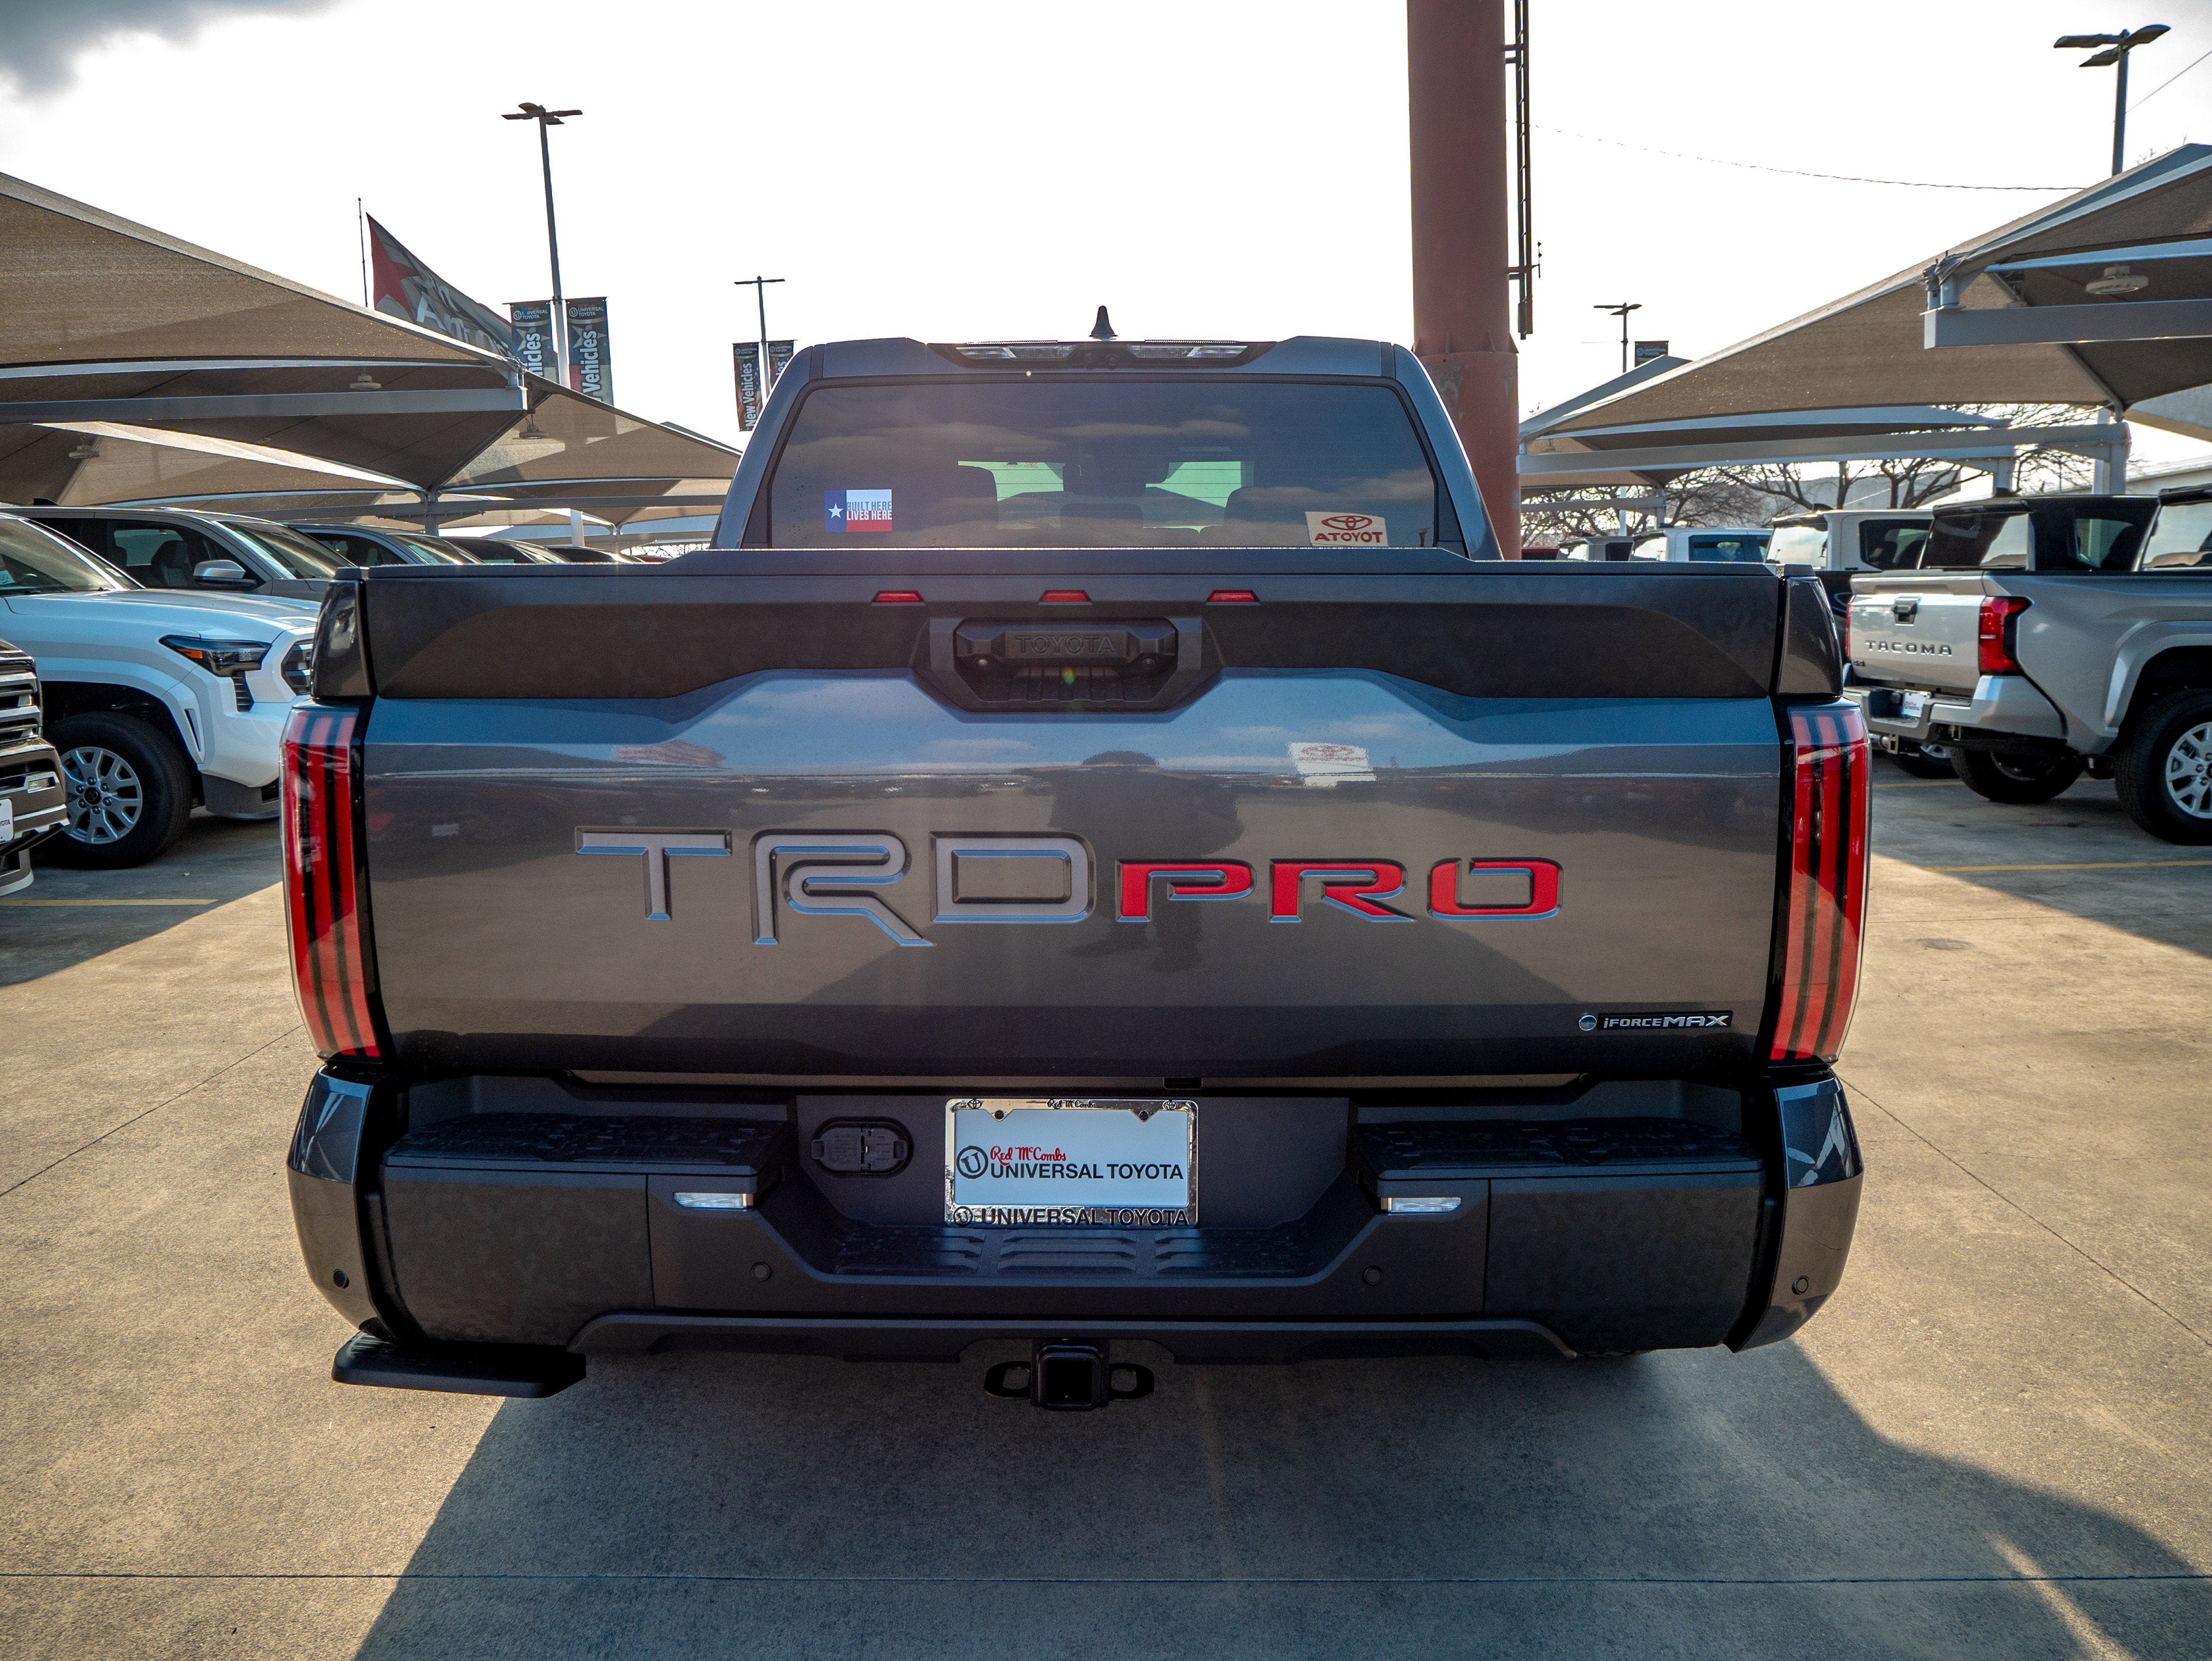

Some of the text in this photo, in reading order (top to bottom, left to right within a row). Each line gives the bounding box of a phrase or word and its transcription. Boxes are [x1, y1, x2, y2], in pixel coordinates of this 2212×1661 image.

[579, 330, 600, 393] Vehicles
[741, 362, 755, 403] Vehicles
[847, 501, 892, 510] BUILT HERE
[847, 510, 892, 520] LIVES HERE
[1016, 635, 1117, 654] TOYOTA
[1865, 640, 1952, 657] TACOMA
[575, 827, 1564, 947] TRD PRO
[1047, 1098, 1063, 1110] Red
[990, 1145, 1066, 1166] Red McCombs
[990, 1162, 1104, 1179] UNIVERSAL
[1107, 1163, 1184, 1179] TOYOTA
[981, 1208, 1104, 1225] UNIVERSAL
[1105, 1208, 1190, 1225] TOYOTA
